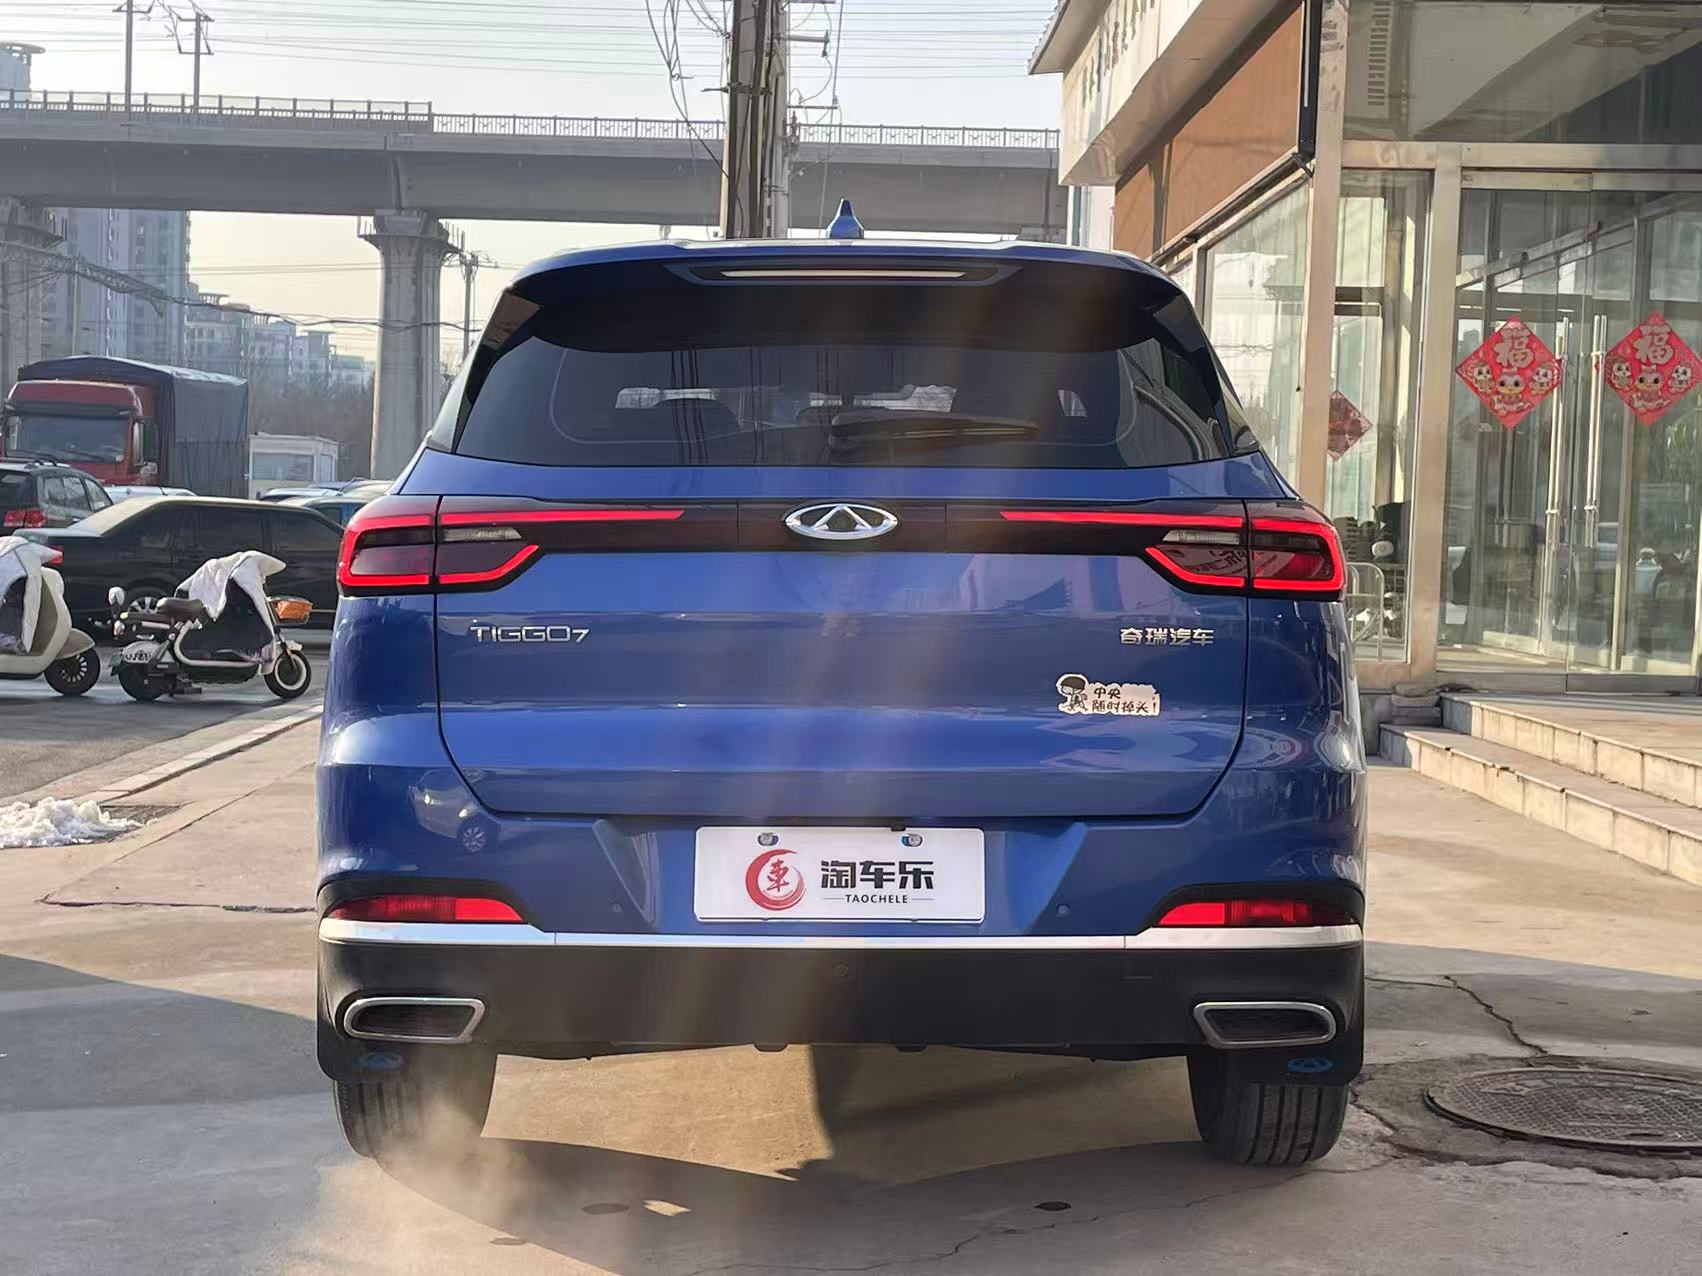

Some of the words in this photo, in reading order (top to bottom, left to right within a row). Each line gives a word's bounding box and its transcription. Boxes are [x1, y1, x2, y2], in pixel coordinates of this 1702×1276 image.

[1494, 326, 1535, 369] 福
[1633, 324, 1674, 365] 福
[1120, 627, 1214, 646] 奇瑞汽车
[1093, 687, 1121, 699] 中央
[820, 860, 934, 889] 淘车乐
[845, 894, 909, 904] TAOCHELE
